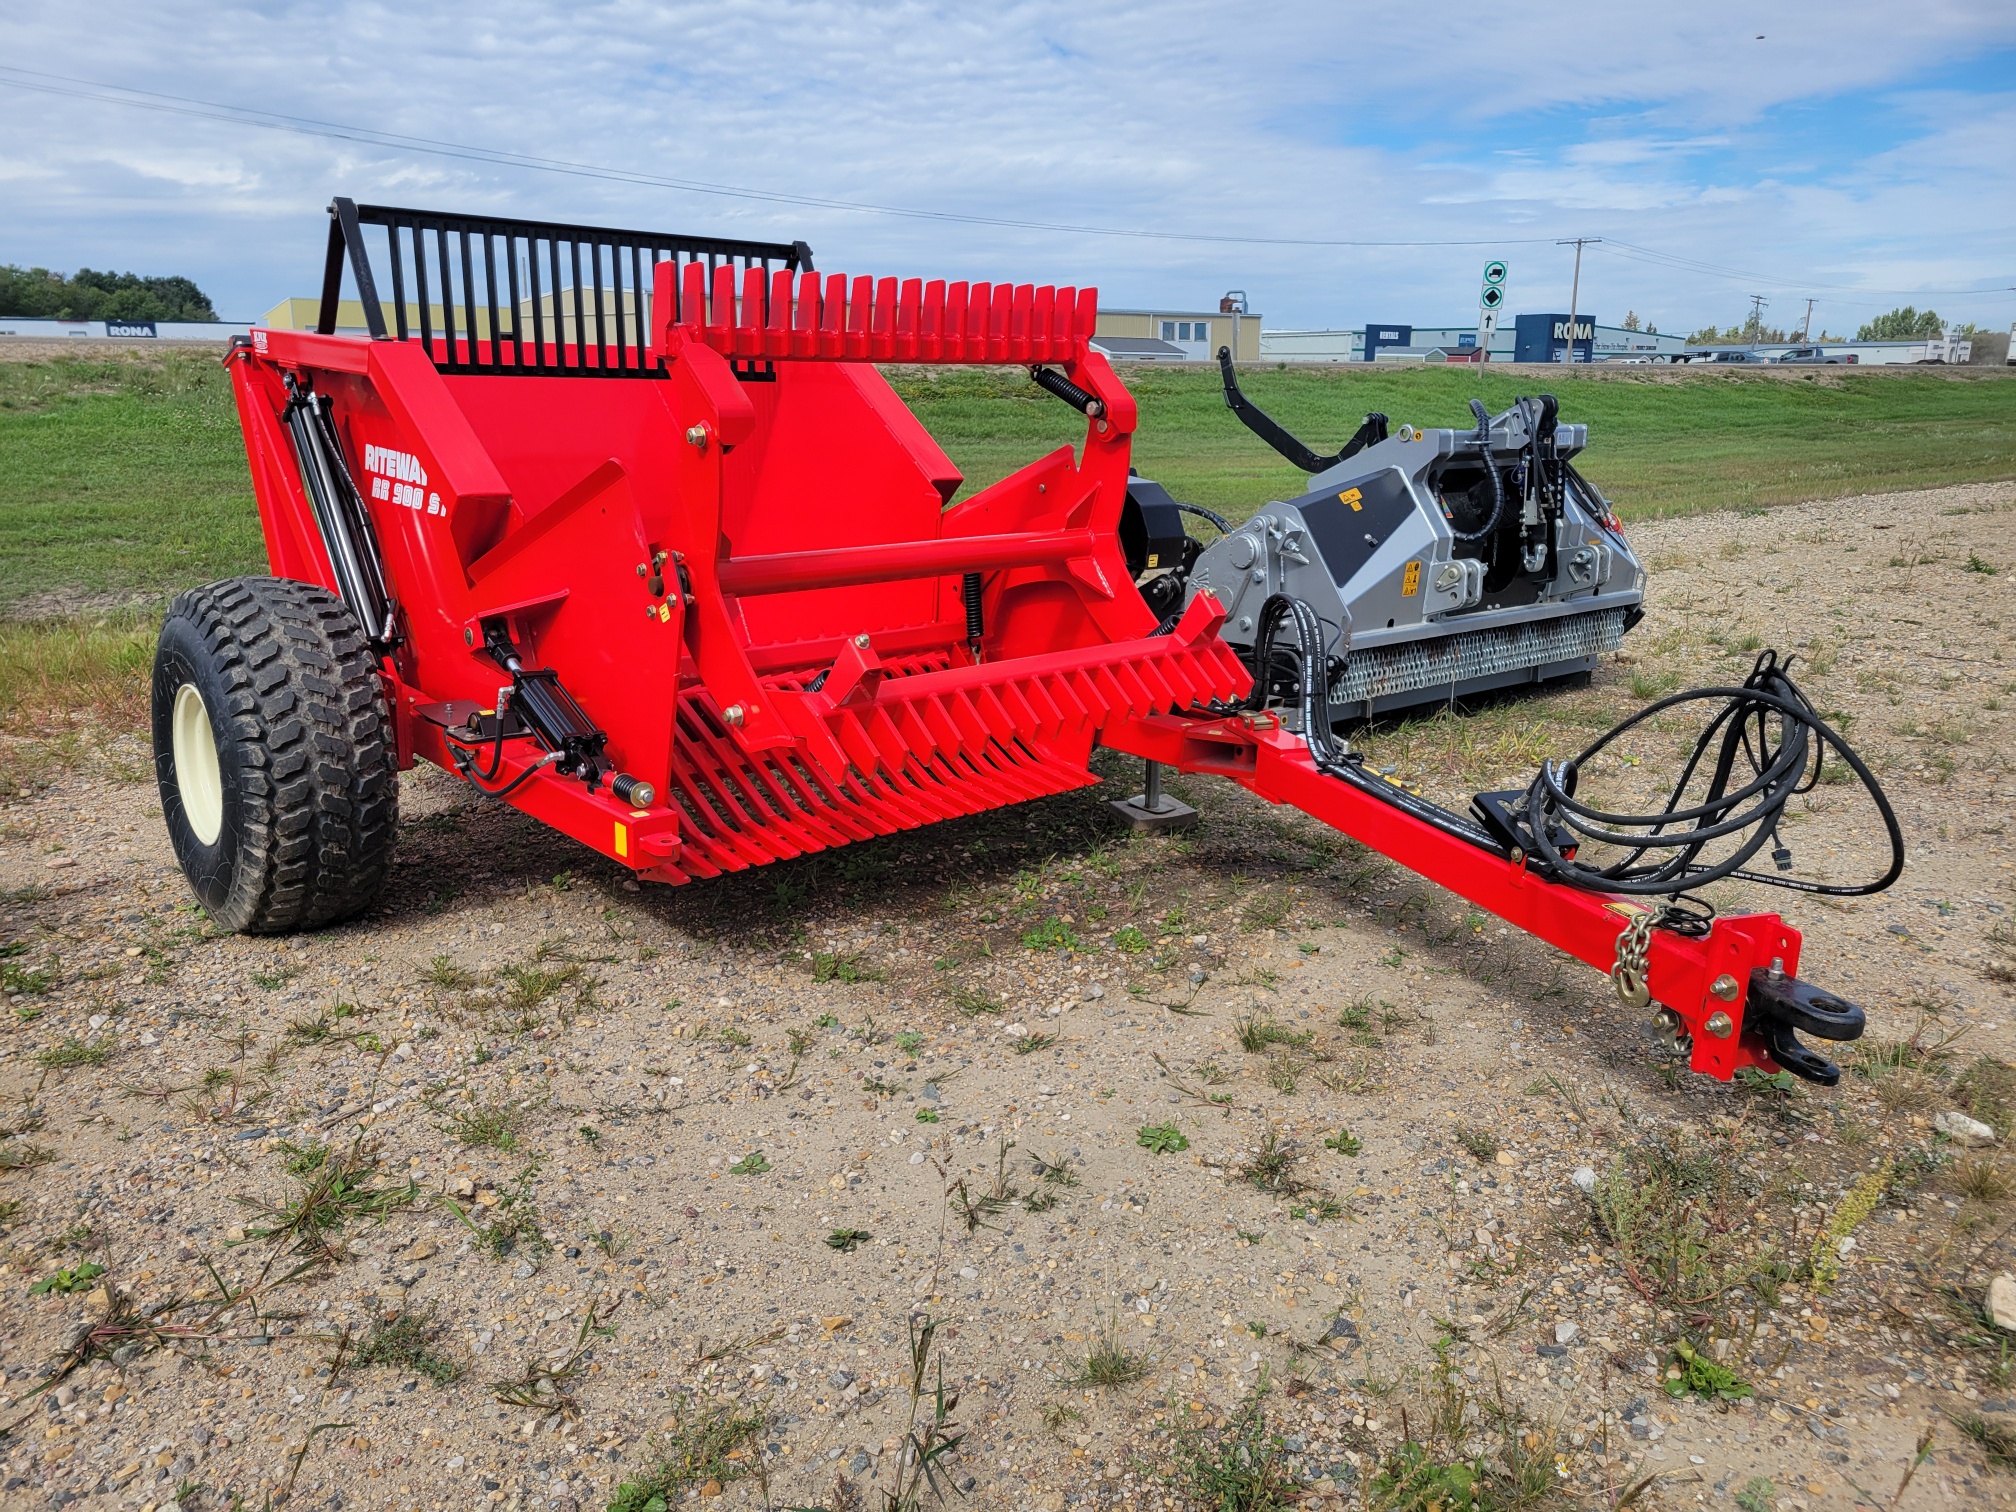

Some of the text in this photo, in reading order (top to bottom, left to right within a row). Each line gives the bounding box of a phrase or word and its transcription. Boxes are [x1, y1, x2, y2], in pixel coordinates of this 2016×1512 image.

[110, 326, 154, 337] RONA
[1553, 322, 1593, 340] RONA
[371, 476, 391, 501] RR
[392, 482, 424, 510] 900
